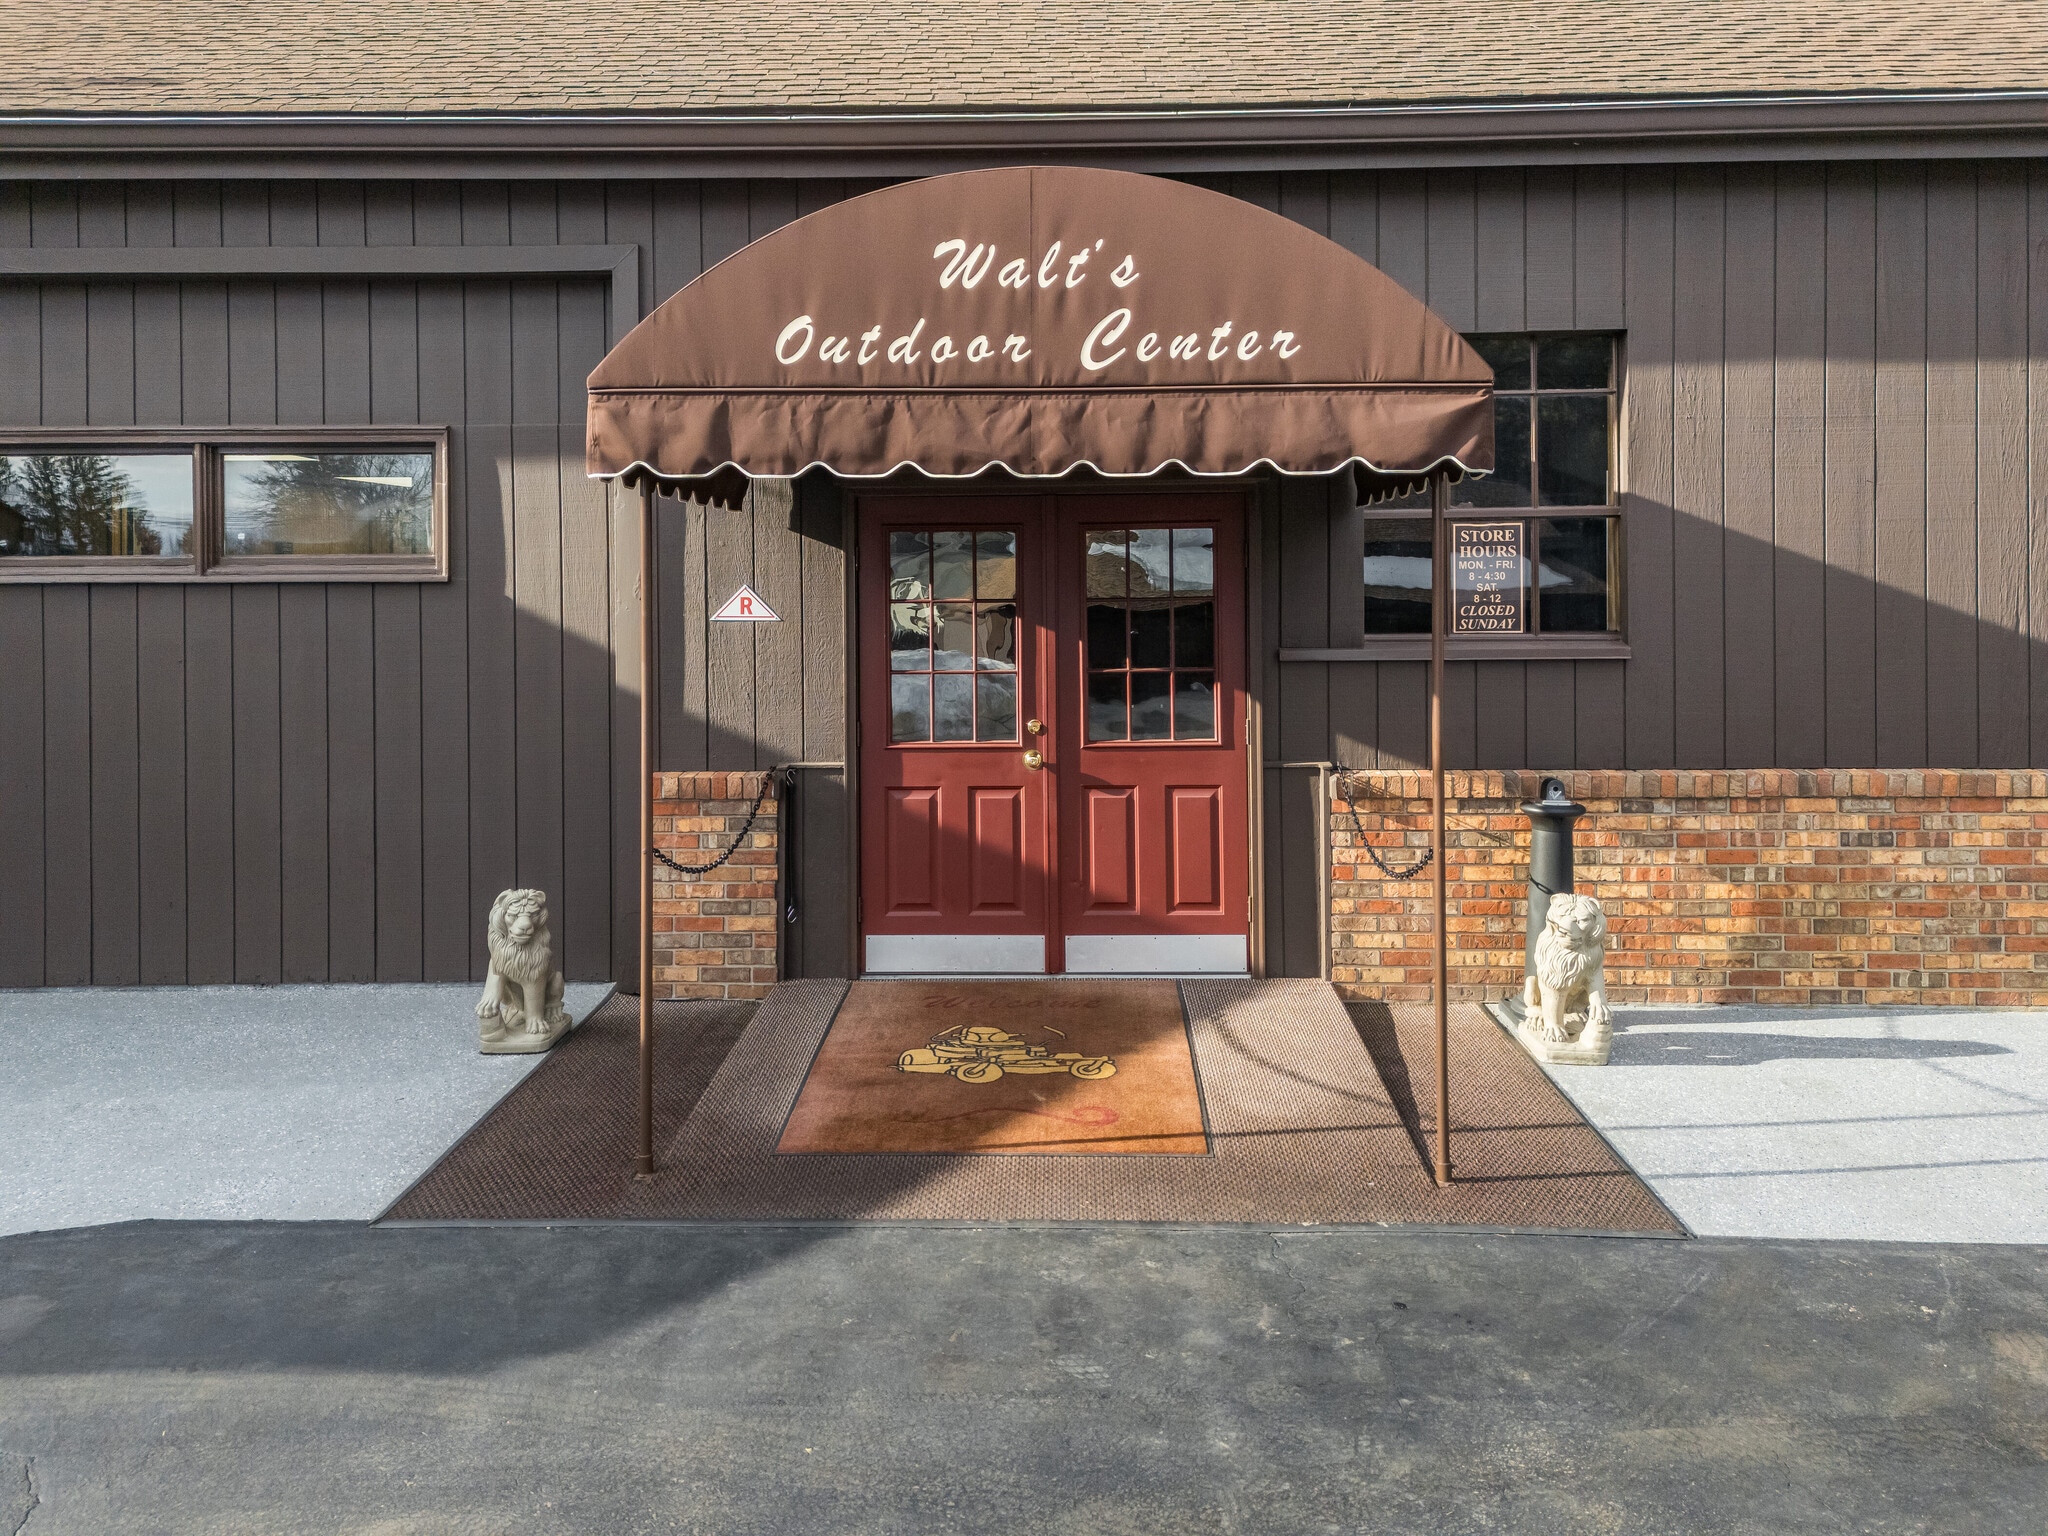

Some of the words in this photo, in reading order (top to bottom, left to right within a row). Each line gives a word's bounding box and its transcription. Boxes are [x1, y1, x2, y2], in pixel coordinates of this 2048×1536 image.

[933, 238, 1140, 289] Walt's
[774, 315, 1032, 366] Outdoor
[1079, 307, 1301, 371] Center
[1460, 530, 1515, 542] STORE
[1459, 545, 1517, 558] HOURS
[1458, 561, 1486, 569] MON.
[1495, 561, 1516, 569] FRI.
[1469, 572, 1475, 581] 8
[1484, 572, 1506, 580] 4:30
[1476, 583, 1499, 592] SAT.
[1473, 594, 1480, 603] 8
[1489, 594, 1502, 603] 12
[740, 597, 753, 615] R
[1460, 605, 1515, 616] CLOSED
[1459, 618, 1516, 630] SUNDAY
[922, 995, 1104, 1010] Welcome
